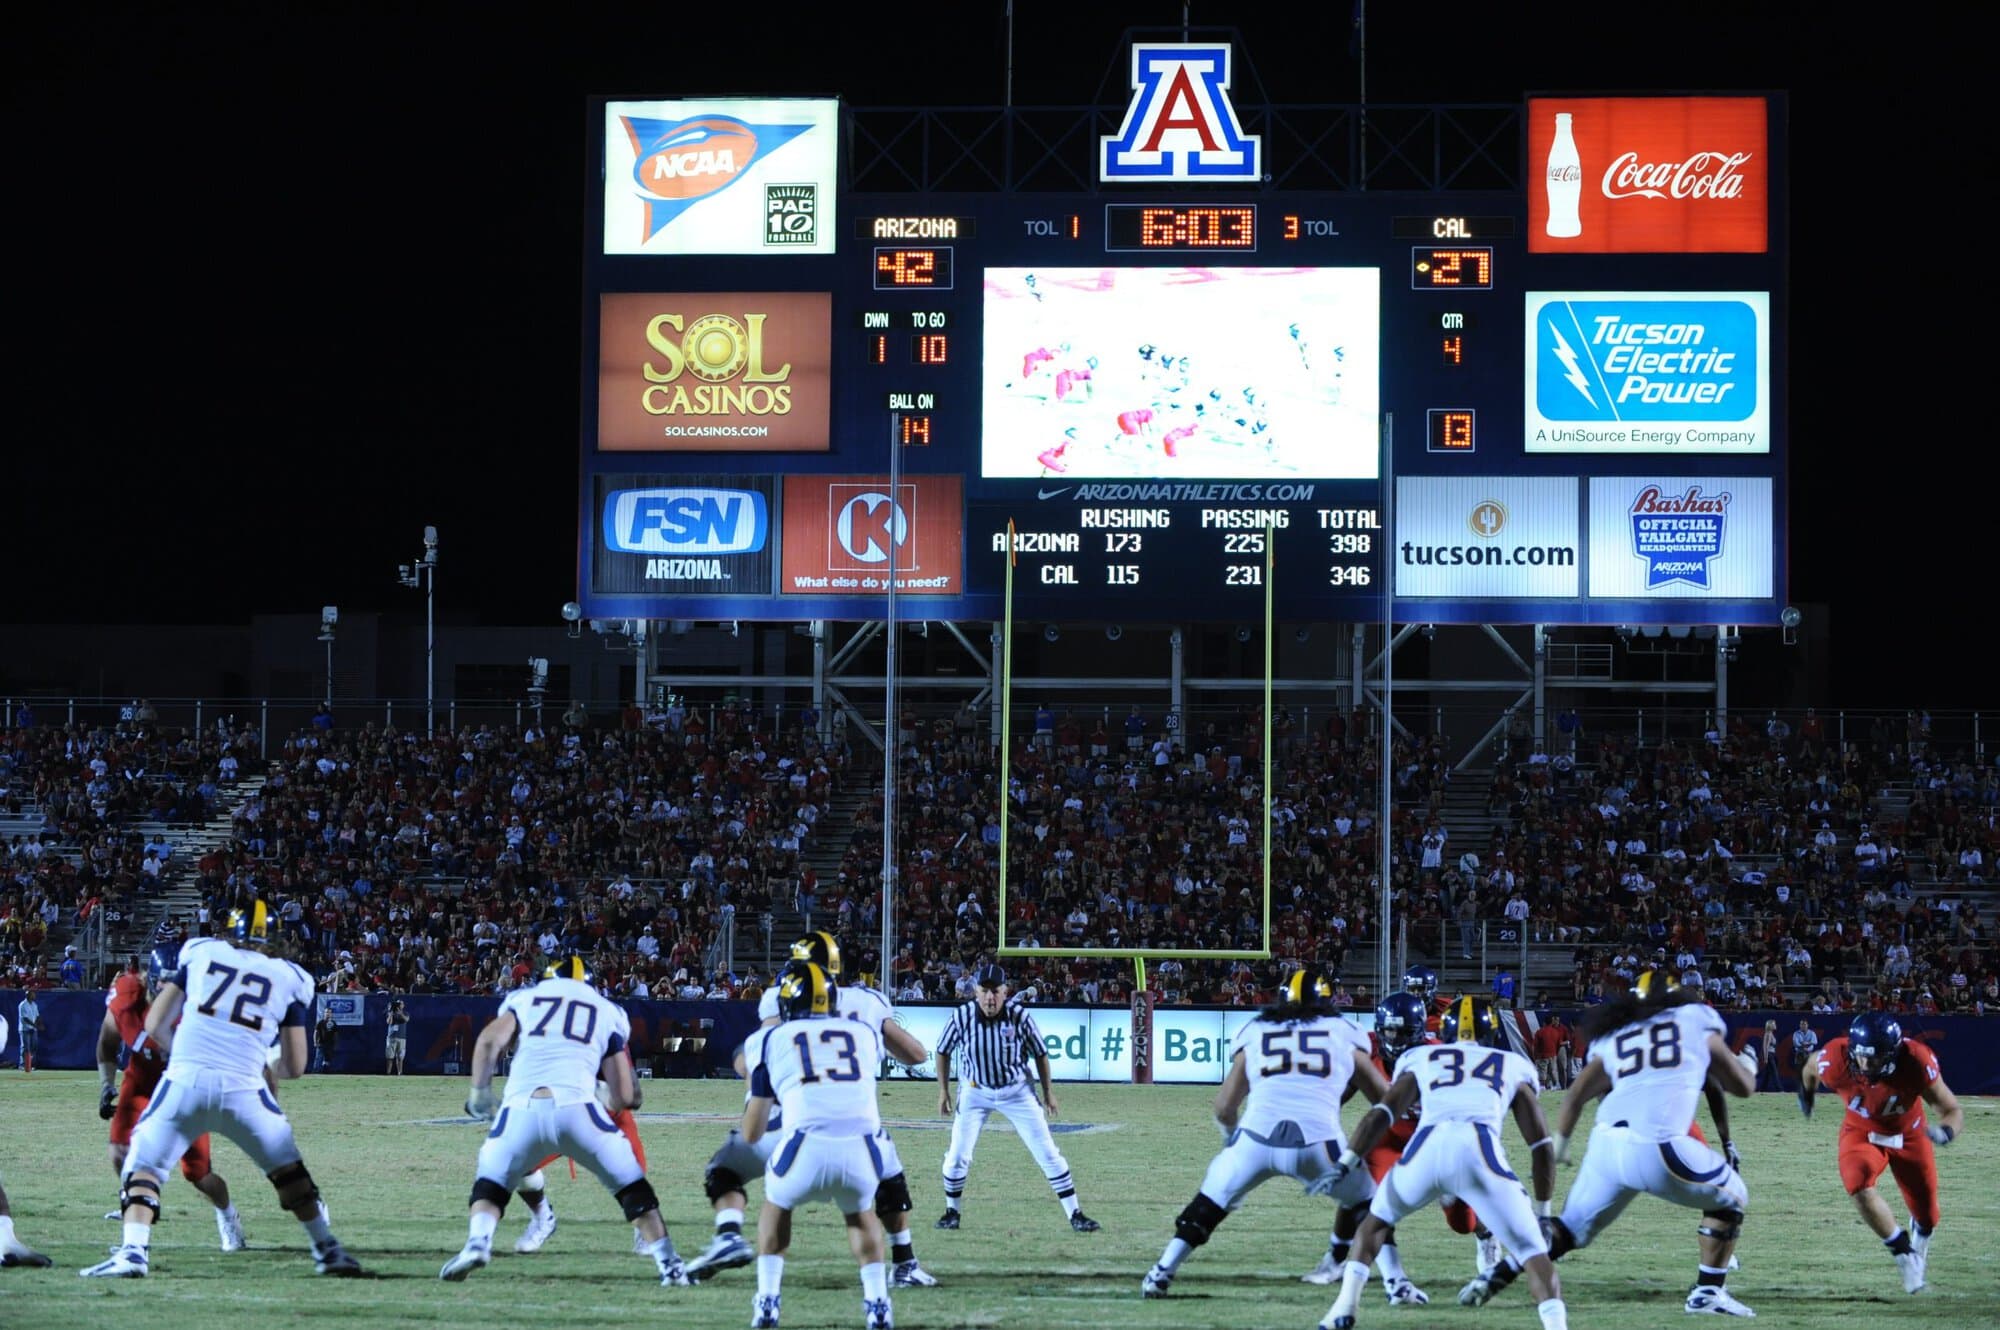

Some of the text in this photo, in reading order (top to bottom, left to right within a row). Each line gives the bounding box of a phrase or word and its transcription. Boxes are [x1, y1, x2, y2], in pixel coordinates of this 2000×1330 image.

[1101, 43, 1261, 182] A
[654, 150, 735, 180] NCAA
[1602, 151, 1752, 199] Coca-Cola
[768, 200, 814, 213] PAC
[768, 214, 814, 233] 10
[874, 218, 956, 238] ARIZONA
[1024, 220, 1059, 236] TOL
[1072, 216, 1079, 239] 1
[1142, 209, 1252, 245] 6:03
[1284, 216, 1298, 239] 3
[1304, 220, 1339, 236] TOL
[1433, 218, 1471, 238] CAL
[878, 252, 933, 283] 42
[1432, 252, 1489, 283] 27
[864, 312, 889, 328] DWN
[912, 312, 945, 328] TO GO
[1442, 313, 1463, 329] QTR
[1592, 316, 1704, 345] Tucson
[643, 313, 792, 383] SOL
[879, 336, 885, 362] 1
[921, 336, 946, 362] 10
[1443, 337, 1460, 363] 4
[1604, 346, 1736, 373] Electric
[641, 385, 792, 415] CASINOS
[1616, 375, 1736, 404] Power
[889, 394, 934, 409] BALL ON
[664, 426, 768, 437] SOLCASINOS.COM
[904, 417, 929, 444] 14
[1535, 429, 1756, 446] A UniSource Energy Company
[1074, 484, 1314, 501] ARIZONAATHLETICS.COM
[629, 496, 743, 545] FSN
[1081, 509, 1381, 529] RUSHING PASSING TOTAL
[1639, 519, 1717, 531] OFFICIAL
[1105, 533, 1142, 552] 173
[1224, 534, 1264, 553] 225
[1330, 534, 1370, 553] 398
[1639, 532, 1717, 543] TAILGATE
[1640, 545, 1716, 553] HEADQUARTERS
[1401, 541, 1574, 567] tucson.com
[645, 559, 722, 580] ARIZONA
[1041, 565, 1370, 586] CAL 115 231 346
[1652, 562, 1704, 572] ARIZONA
[794, 576, 948, 590] What else do yu need?
[1166, 715, 1178, 728] 28
[105, 911, 121, 921] 26
[1500, 930, 1517, 940] 29
[197, 960, 273, 1032] 72
[527, 996, 598, 1045] 70
[1134, 996, 1148, 1067] ARIZONA
[793, 1029, 862, 1084] 13
[1260, 1030, 1331, 1078] 55
[1615, 1021, 1682, 1079] 58
[1428, 1048, 1506, 1095] 34
